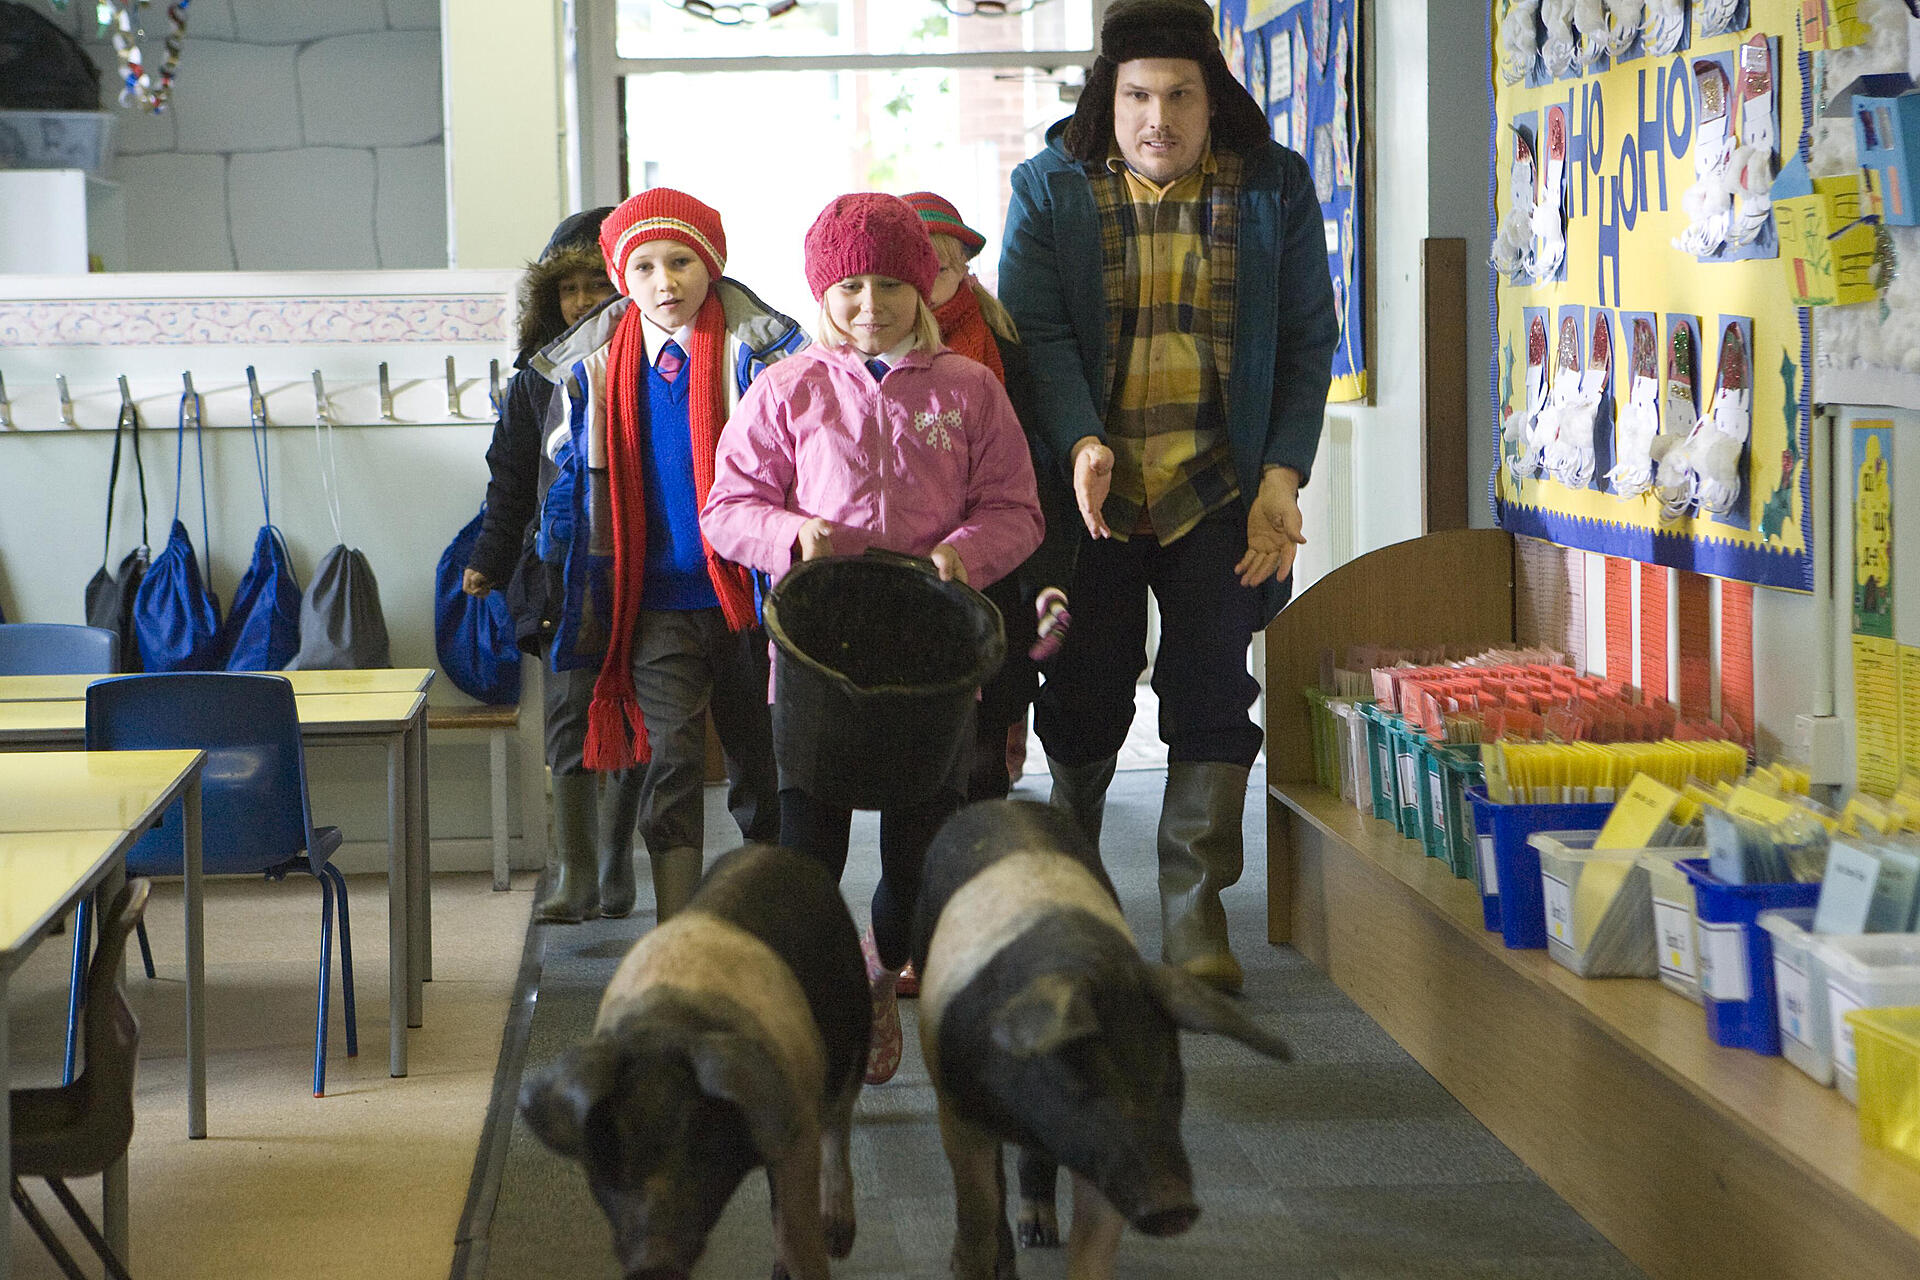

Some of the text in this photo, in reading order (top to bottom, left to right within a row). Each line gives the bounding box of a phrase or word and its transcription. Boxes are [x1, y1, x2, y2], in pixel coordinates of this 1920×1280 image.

[1568, 56, 1692, 307] HO HO HO
